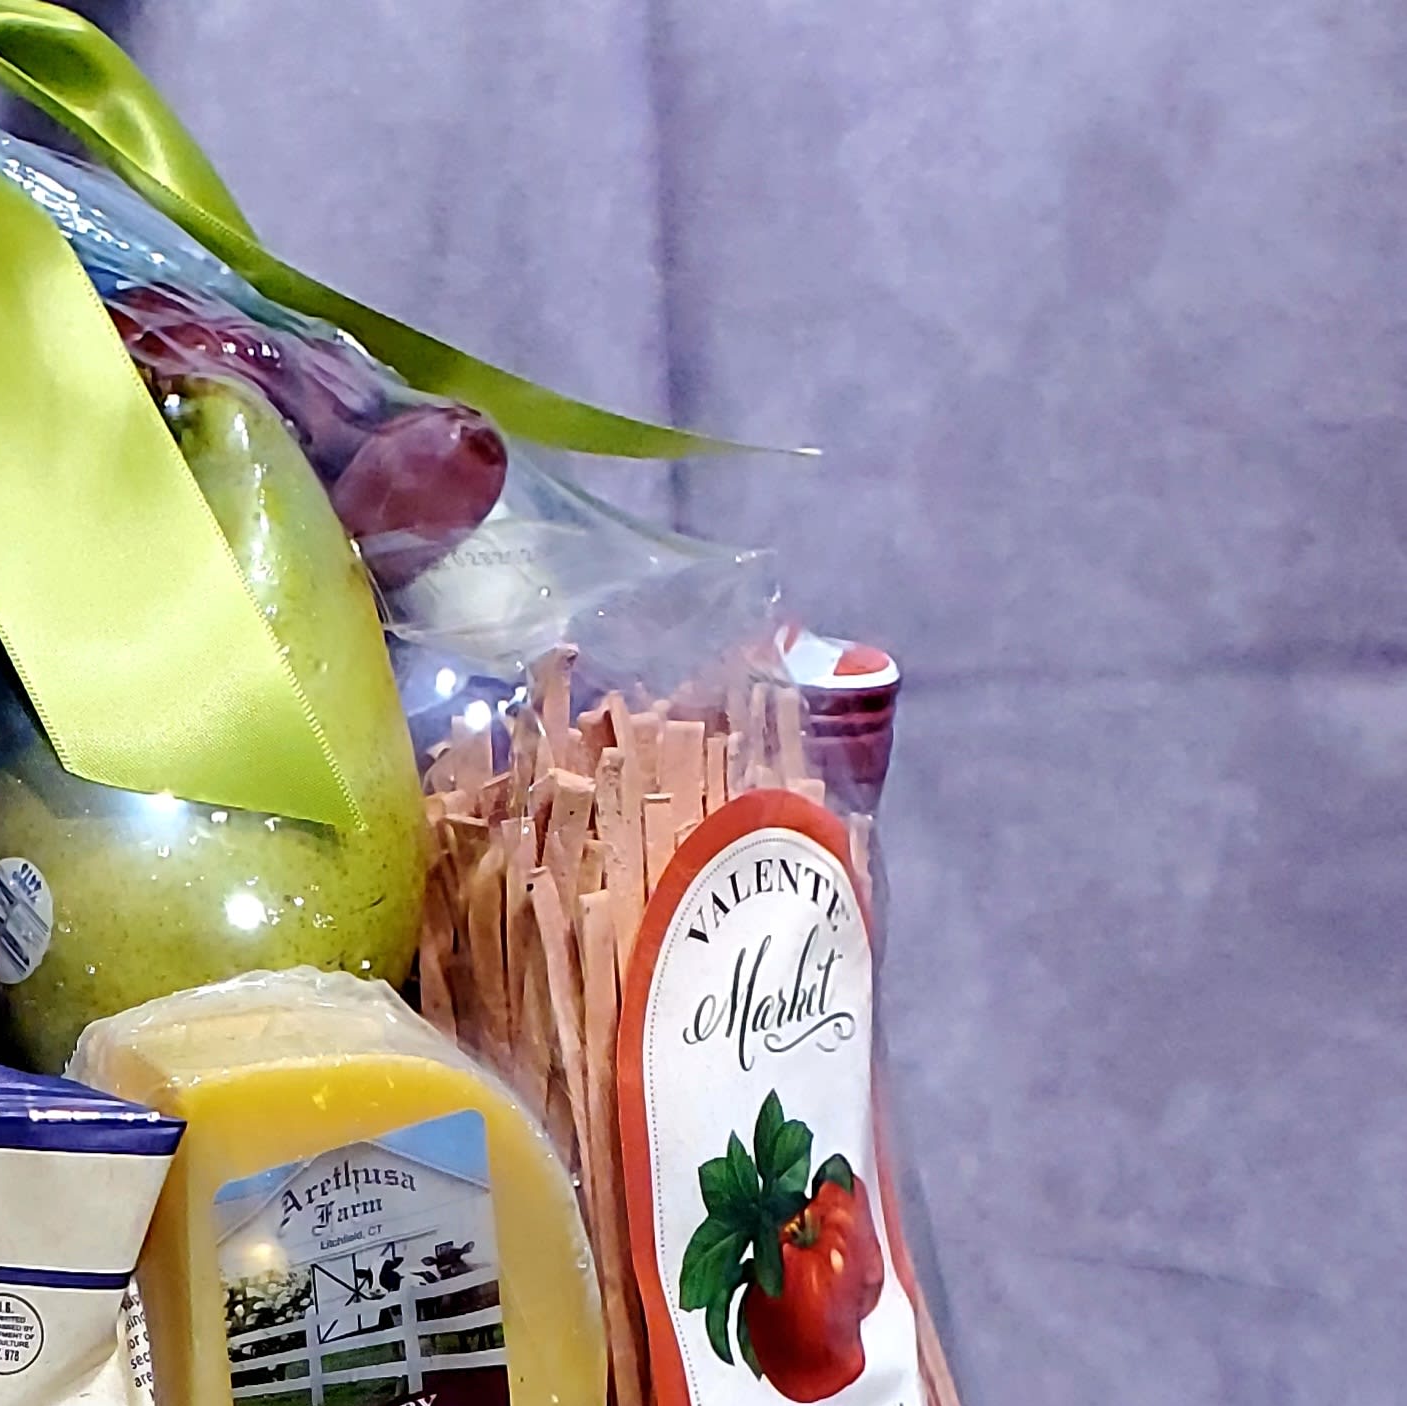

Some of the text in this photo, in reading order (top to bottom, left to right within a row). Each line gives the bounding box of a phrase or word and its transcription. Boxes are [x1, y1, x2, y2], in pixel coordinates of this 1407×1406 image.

[685, 858, 850, 943] VALENTE
[683, 924, 856, 1072] Market
[276, 1160, 416, 1237] Arethusa
[312, 1198, 383, 1237] Farm
[368, 1224, 382, 1236] CT
